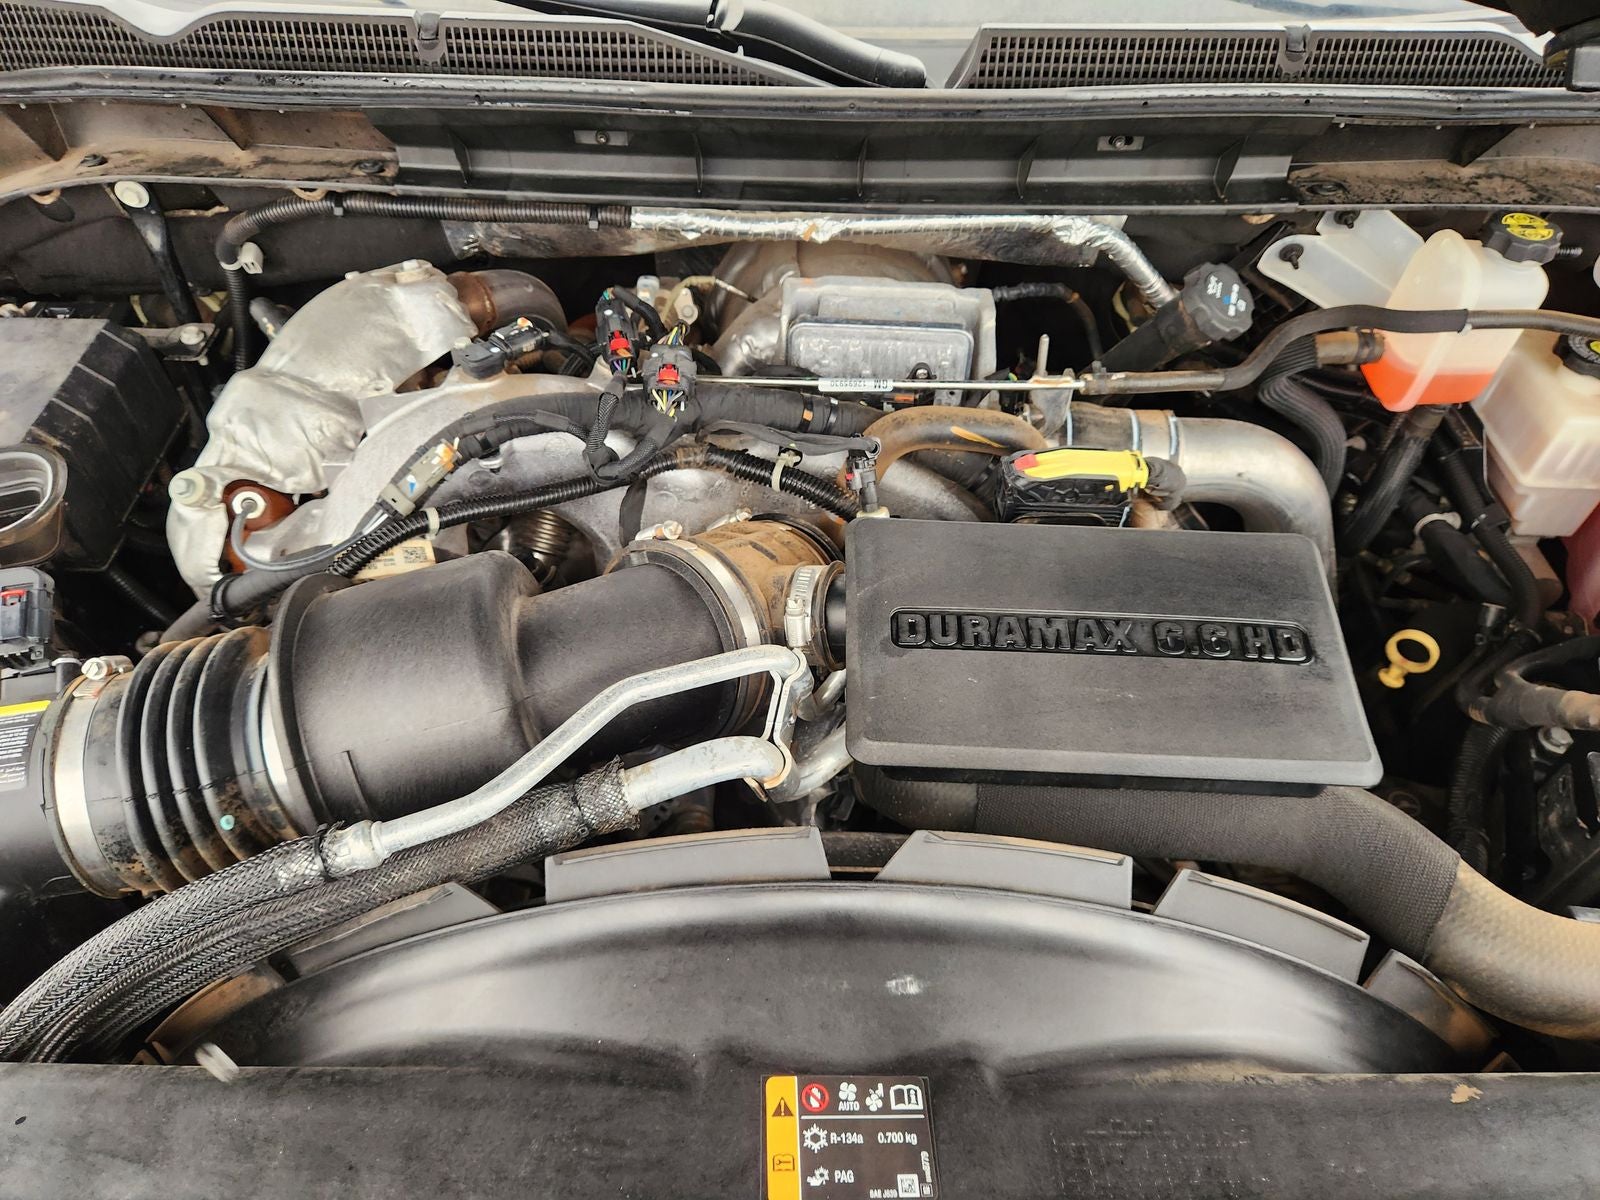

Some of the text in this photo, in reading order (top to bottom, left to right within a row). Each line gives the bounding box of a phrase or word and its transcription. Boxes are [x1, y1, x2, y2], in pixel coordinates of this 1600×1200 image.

[873, 379, 888, 389] GM
[896, 611, 1309, 662] DURAMAX 6.6 HD
[838, 1101, 860, 1111] AUTO
[830, 1132, 917, 1145] R-134a 0.700 kg
[834, 1170, 854, 1183] PAG
